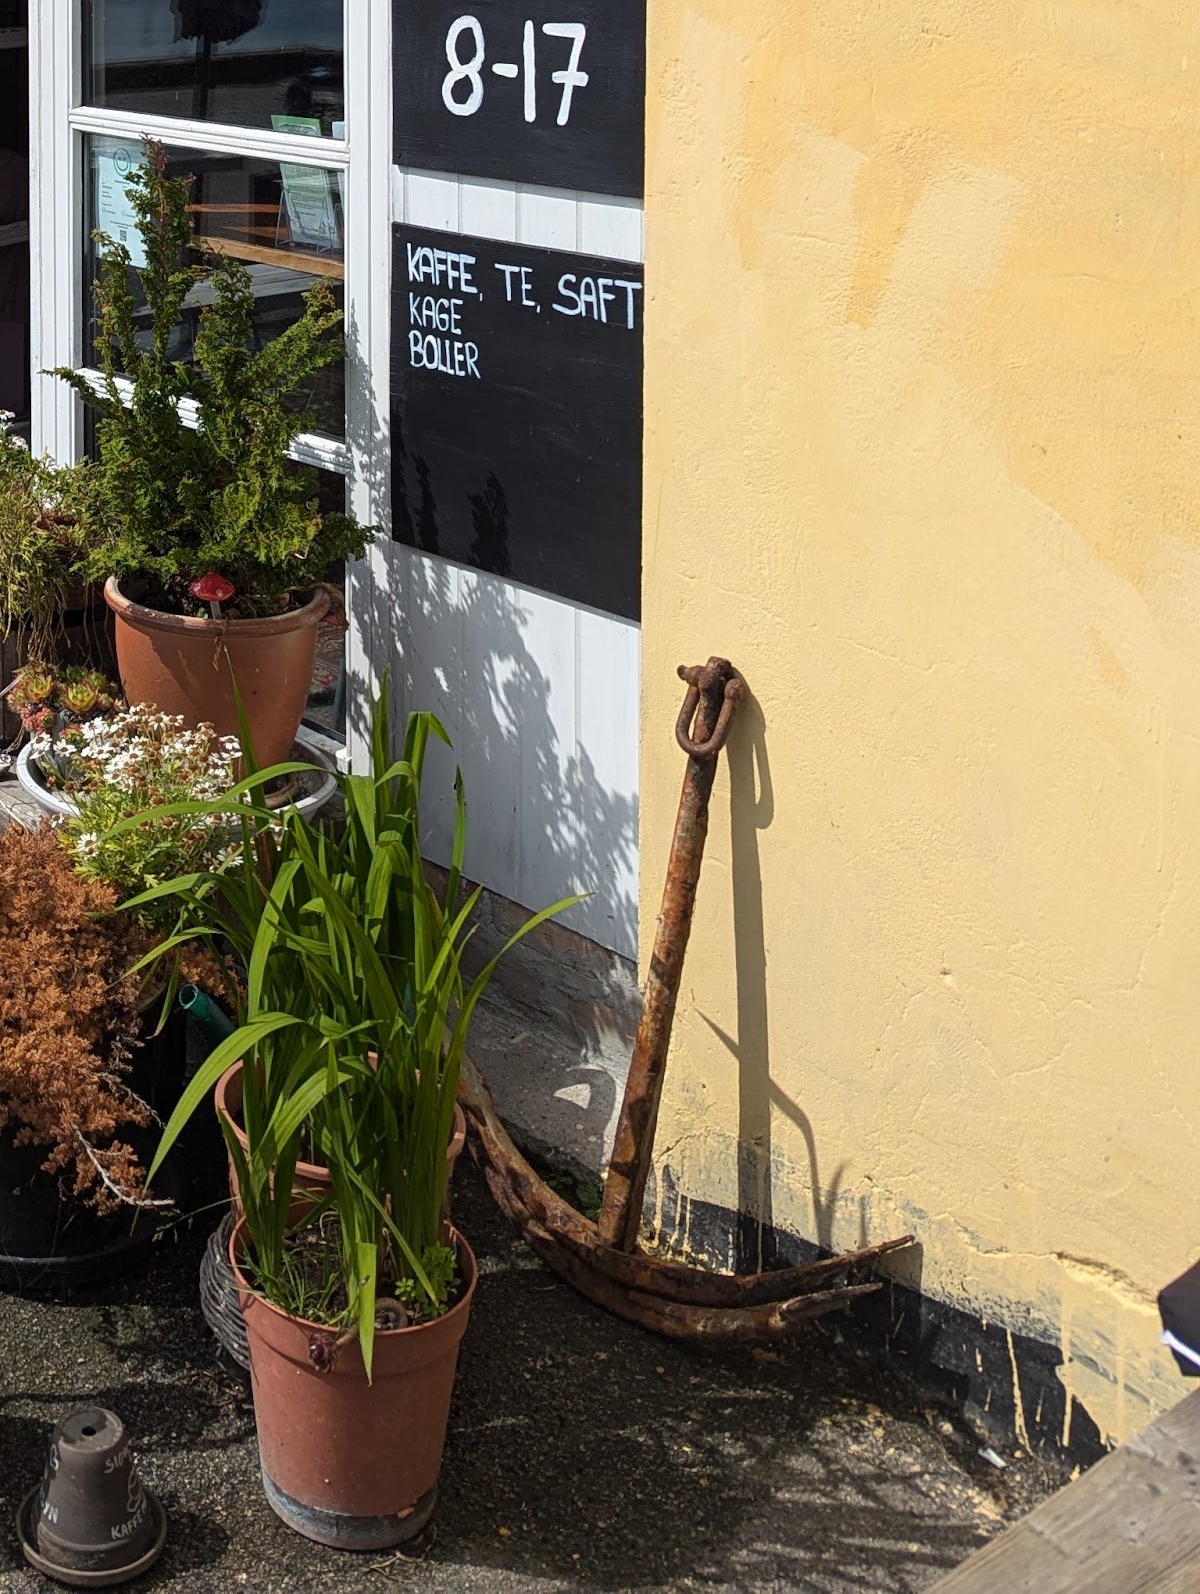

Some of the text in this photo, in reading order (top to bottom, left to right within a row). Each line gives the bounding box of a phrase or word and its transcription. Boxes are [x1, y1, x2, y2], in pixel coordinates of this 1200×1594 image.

[441, 15, 589, 126] 8-17
[406, 242, 643, 330] KAFFE, TE, SAFT
[409, 291, 464, 335] KAGE
[408, 329, 481, 379] BOLLER
